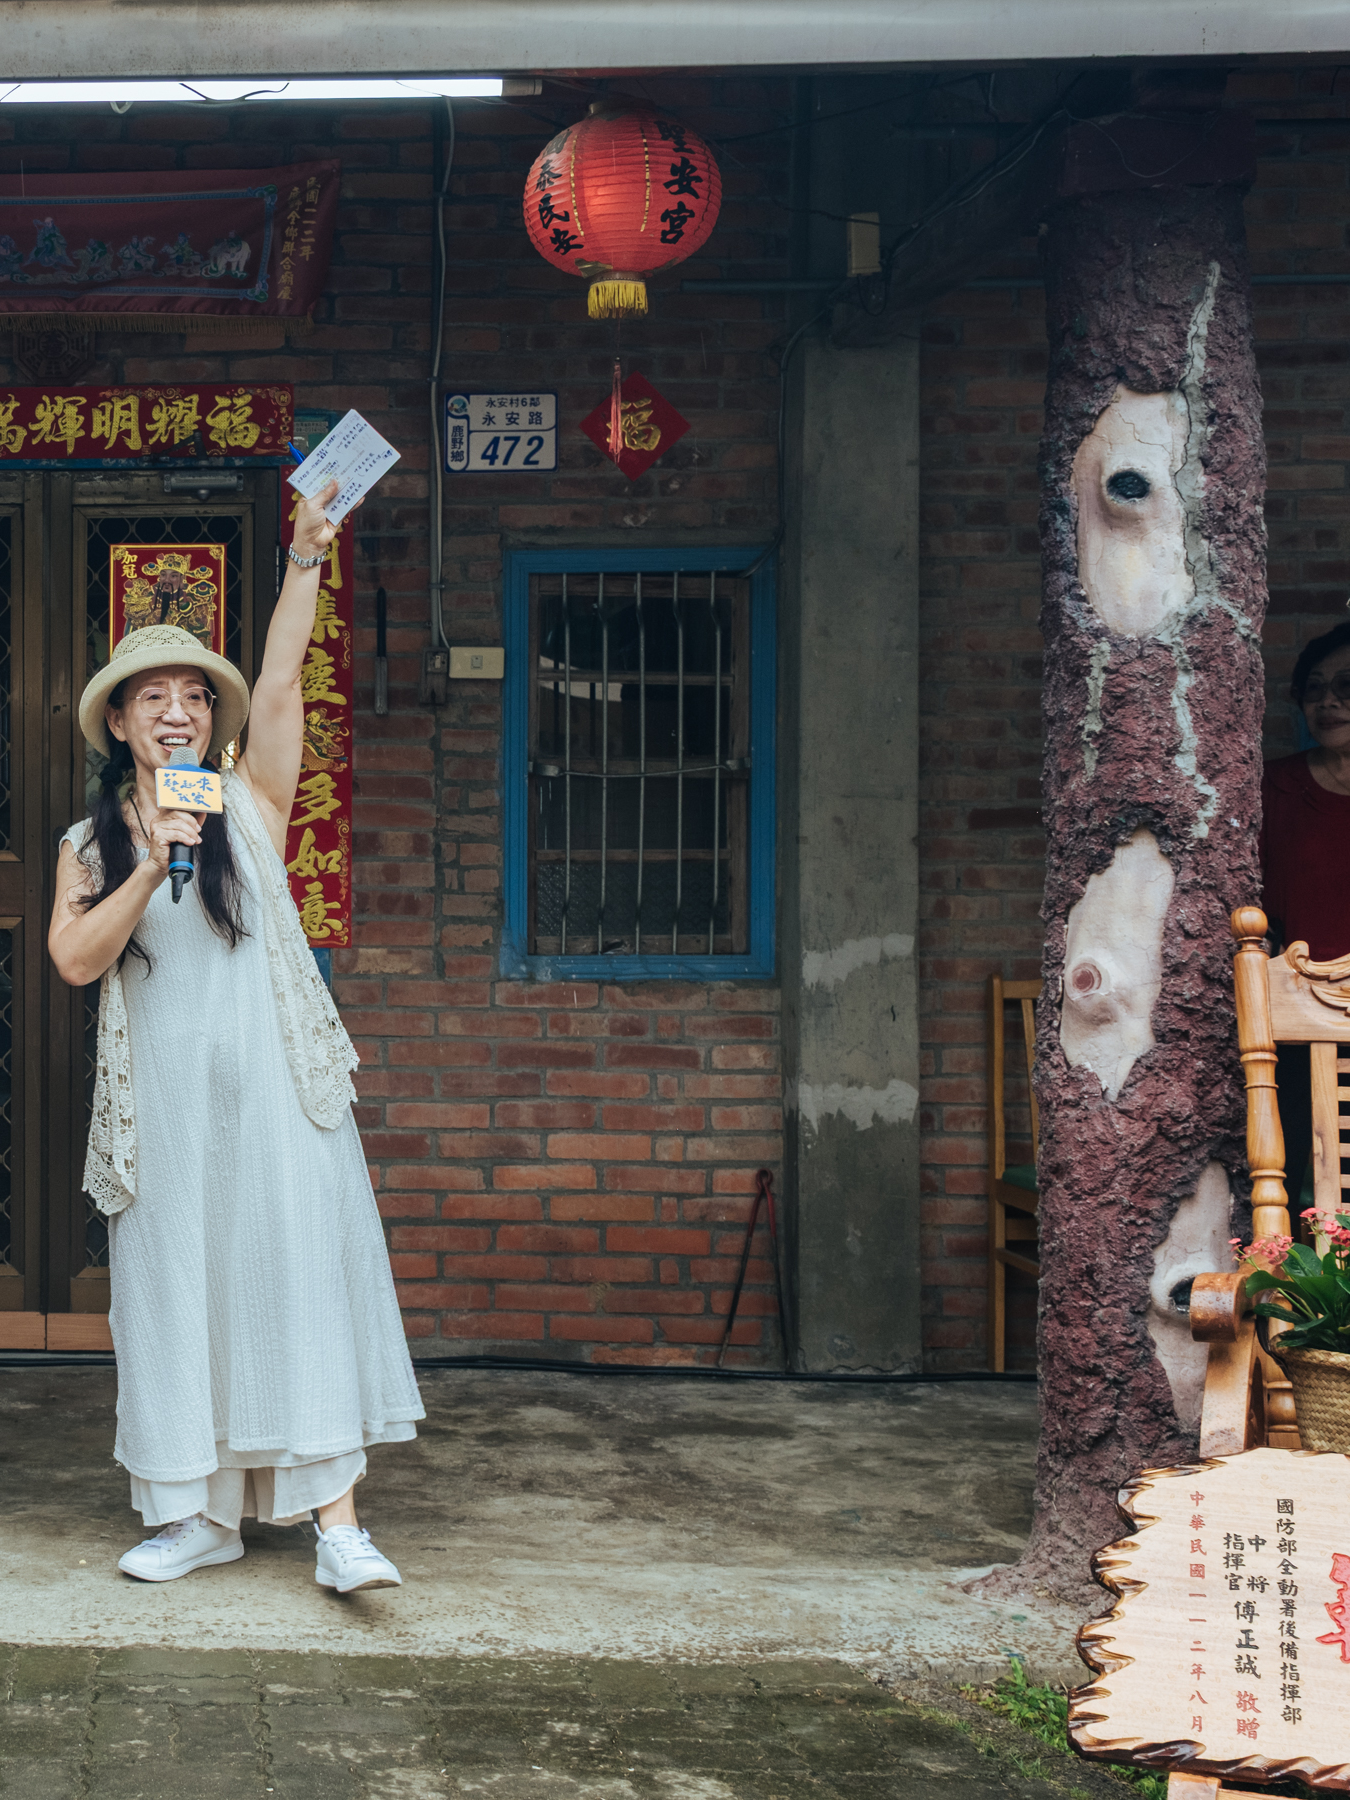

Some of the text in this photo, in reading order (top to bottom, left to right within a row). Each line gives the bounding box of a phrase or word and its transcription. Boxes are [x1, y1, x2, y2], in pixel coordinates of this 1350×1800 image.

[534, 127, 585, 256] 國泰民安
[653, 119, 704, 246] 聖安宮
[481, 411, 544, 426] 永安路
[485, 397, 541, 408] 永安村6鄰
[605, 396, 662, 453] 福
[450, 424, 465, 463] 鹿野鄉
[480, 435, 545, 467] 472
[120, 551, 138, 579] 加冠
[287, 490, 349, 940] 集慶多如意
[1188, 1490, 1208, 1733] 中華民國一一二年八月
[1275, 1497, 1303, 1727] 國防部全動署後備指揮部
